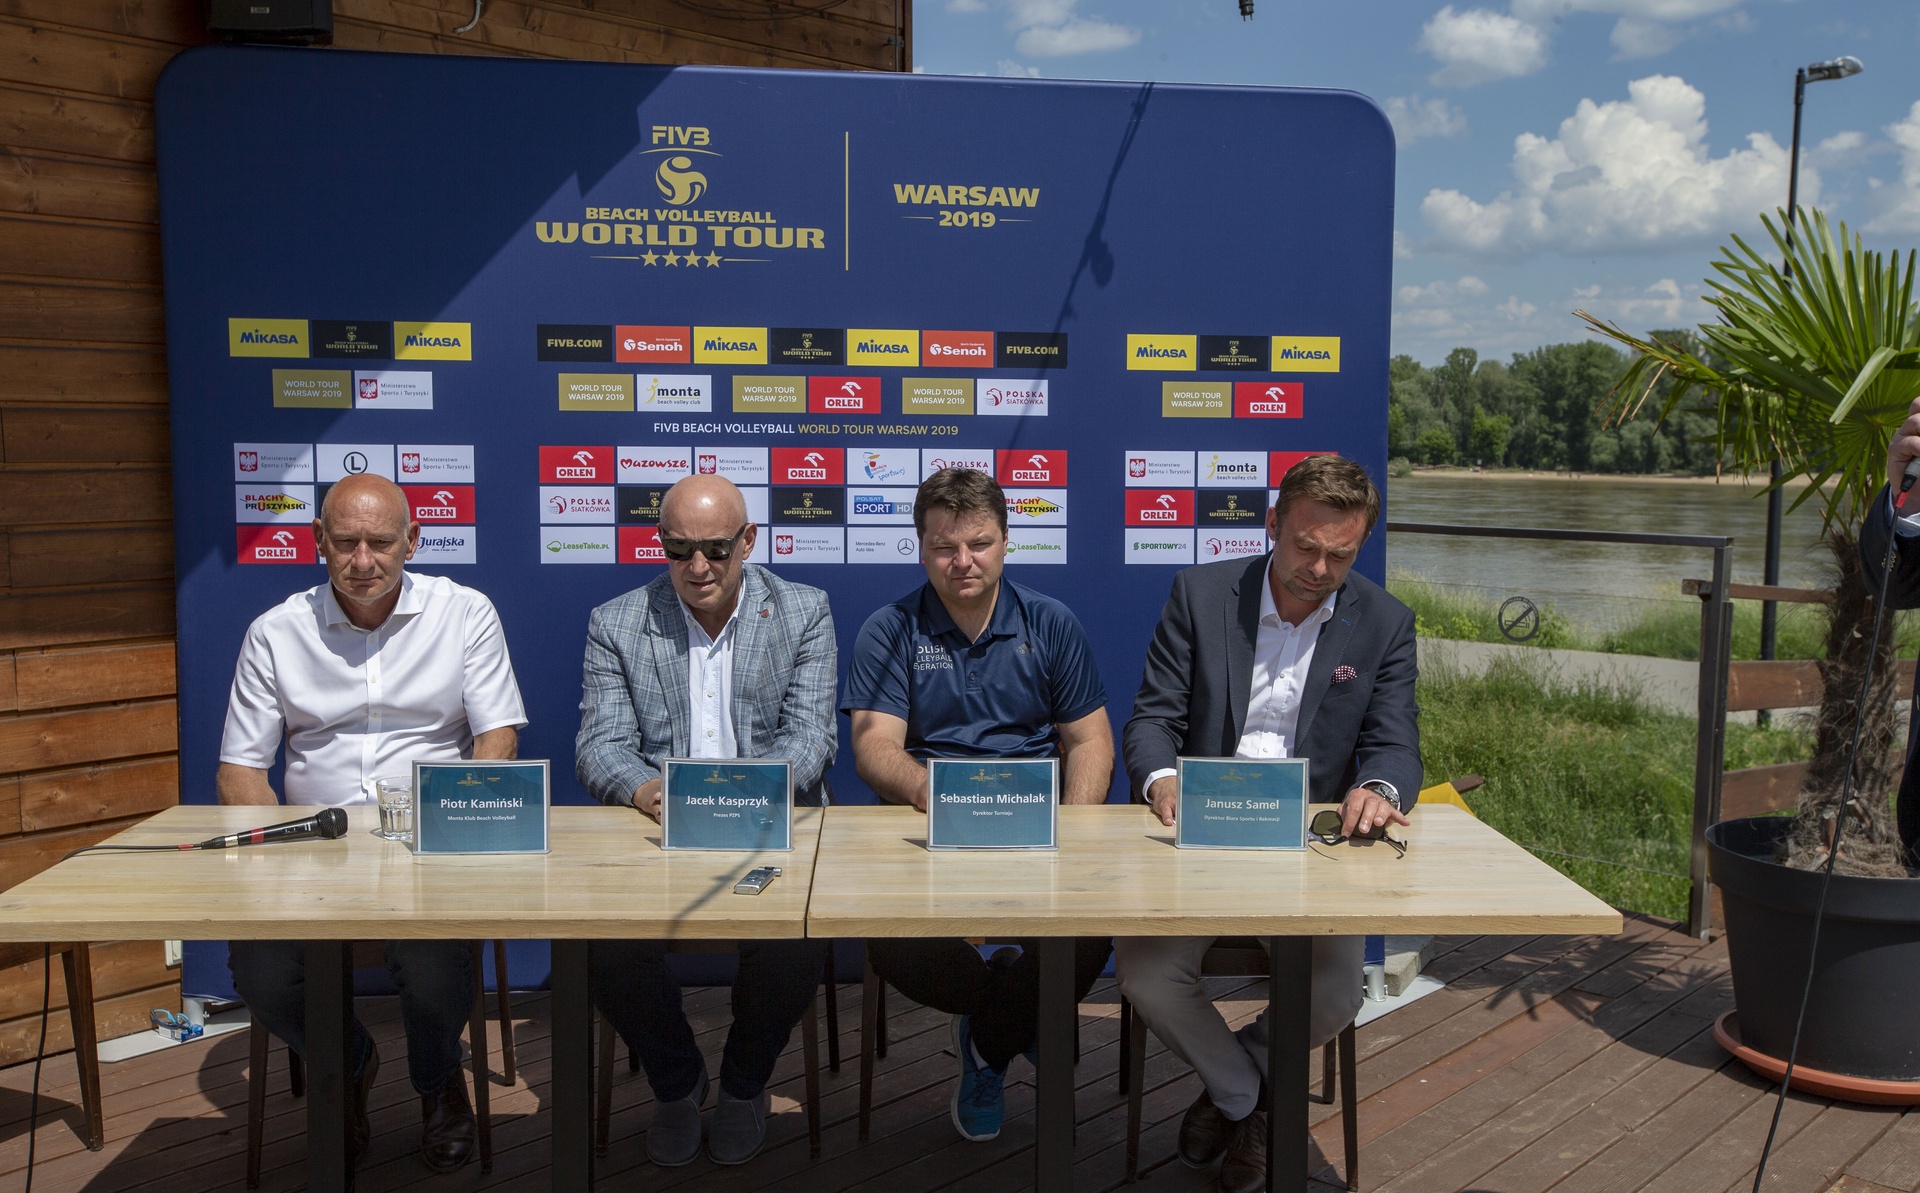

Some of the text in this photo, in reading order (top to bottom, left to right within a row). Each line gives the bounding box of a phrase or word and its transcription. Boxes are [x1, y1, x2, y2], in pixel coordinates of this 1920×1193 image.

[652, 125, 710, 145] FIVB
[894, 183, 1040, 207] WARSAW
[586, 207, 776, 224] BEACH VOLLEYBALL
[938, 210, 996, 227] 2019
[535, 221, 825, 249] WORLD TOUR
[547, 338, 602, 348] FIVB.COM
[637, 341, 683, 351] Senoh
[942, 345, 987, 356] Senoh
[1006, 345, 1059, 355] FIVB.COM
[285, 380, 339, 389] WORLD TOUR
[570, 384, 622, 392] WORLD TOUR
[283, 389, 342, 398] WARSAW 2019
[657, 387, 701, 397] monta
[744, 386, 795, 394] WORLD TOUR
[913, 388, 963, 396] WORLD TOUR
[1006, 390, 1044, 398] POLSKA
[568, 393, 624, 401] WARSAW 2019
[778, 395, 797, 403] 2019
[946, 397, 965, 405] 2019
[827, 399, 861, 407] ORLEN
[1171, 400, 1223, 408] WARSAW 2019
[1252, 404, 1284, 412] ORLEN
[654, 423, 959, 435] FIVB BEACH VOLLEYBALL WORLD TOUR WARSAW 2019
[284, 462, 310, 470] Turystyki
[350, 456, 361, 470] L
[1216, 462, 1257, 473] monta
[558, 468, 593, 477] ORLEN
[790, 470, 824, 478] ORLEN
[1014, 471, 1046, 480] ORLEN
[245, 494, 285, 502] BLACHY
[245, 501, 306, 512] PRUSZYŃSKI
[856, 503, 911, 513] SPORT HD
[419, 508, 454, 517] ORLEN
[1143, 511, 1175, 520] ORLEN
[418, 536, 465, 549] Jurajska
[1140, 542, 1187, 550] SPORTOWY24
[258, 548, 294, 558] ORLEN
[637, 549, 664, 557] ORLE
[918, 645, 946, 653] OLISH
[440, 797, 523, 809] Piotr Kamiński
[686, 795, 769, 808] Jacek Kasprzyk
[940, 793, 1045, 804] Sebastian Michalak
[1205, 798, 1280, 810] Janusz Samel
